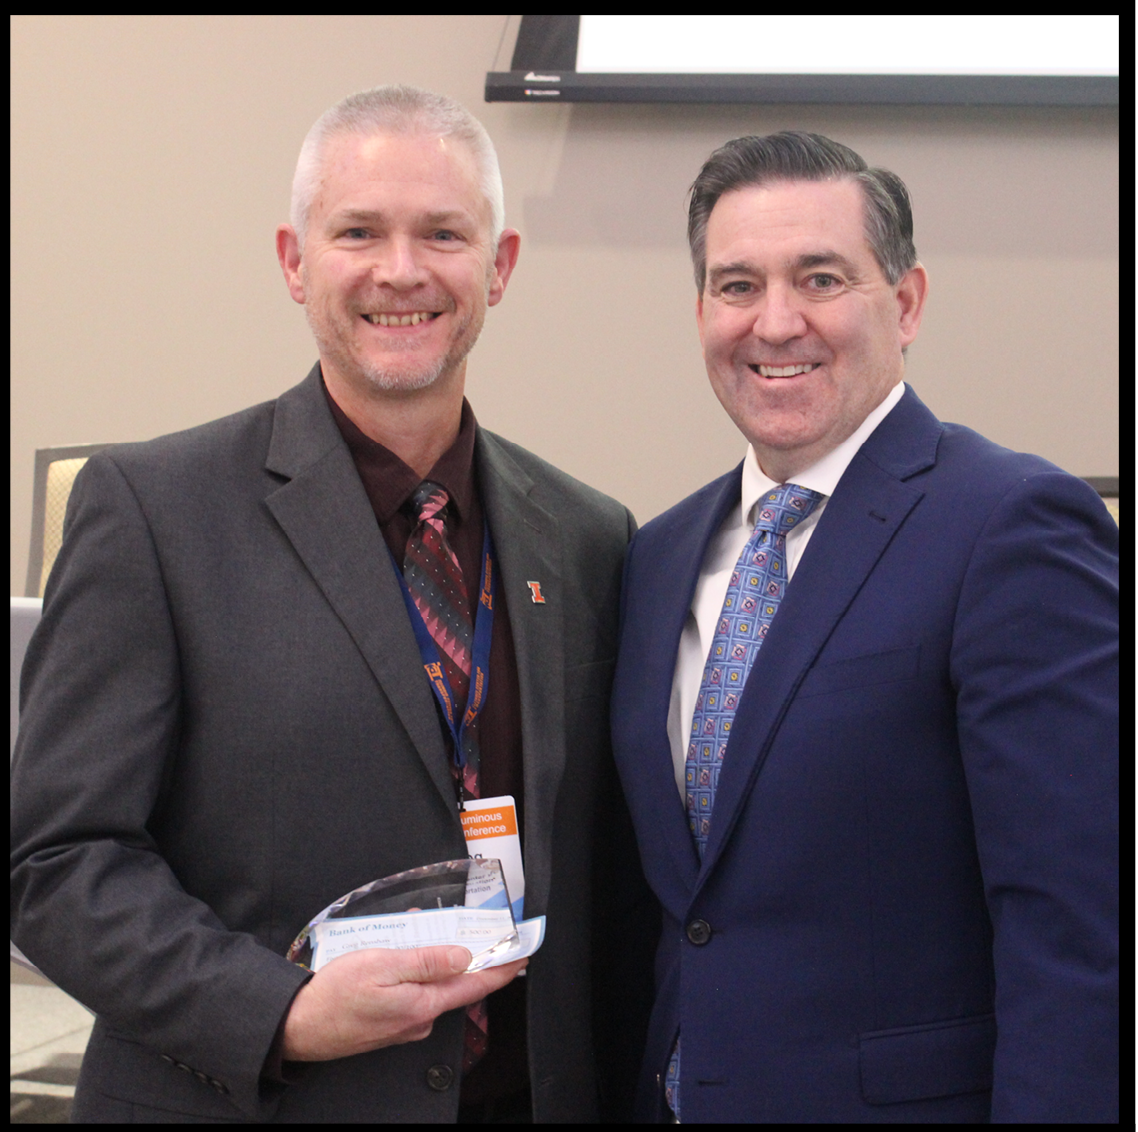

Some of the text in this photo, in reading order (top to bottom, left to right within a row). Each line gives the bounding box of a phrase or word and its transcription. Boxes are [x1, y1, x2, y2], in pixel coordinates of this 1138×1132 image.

[329, 921, 408, 937] Bank of Money
